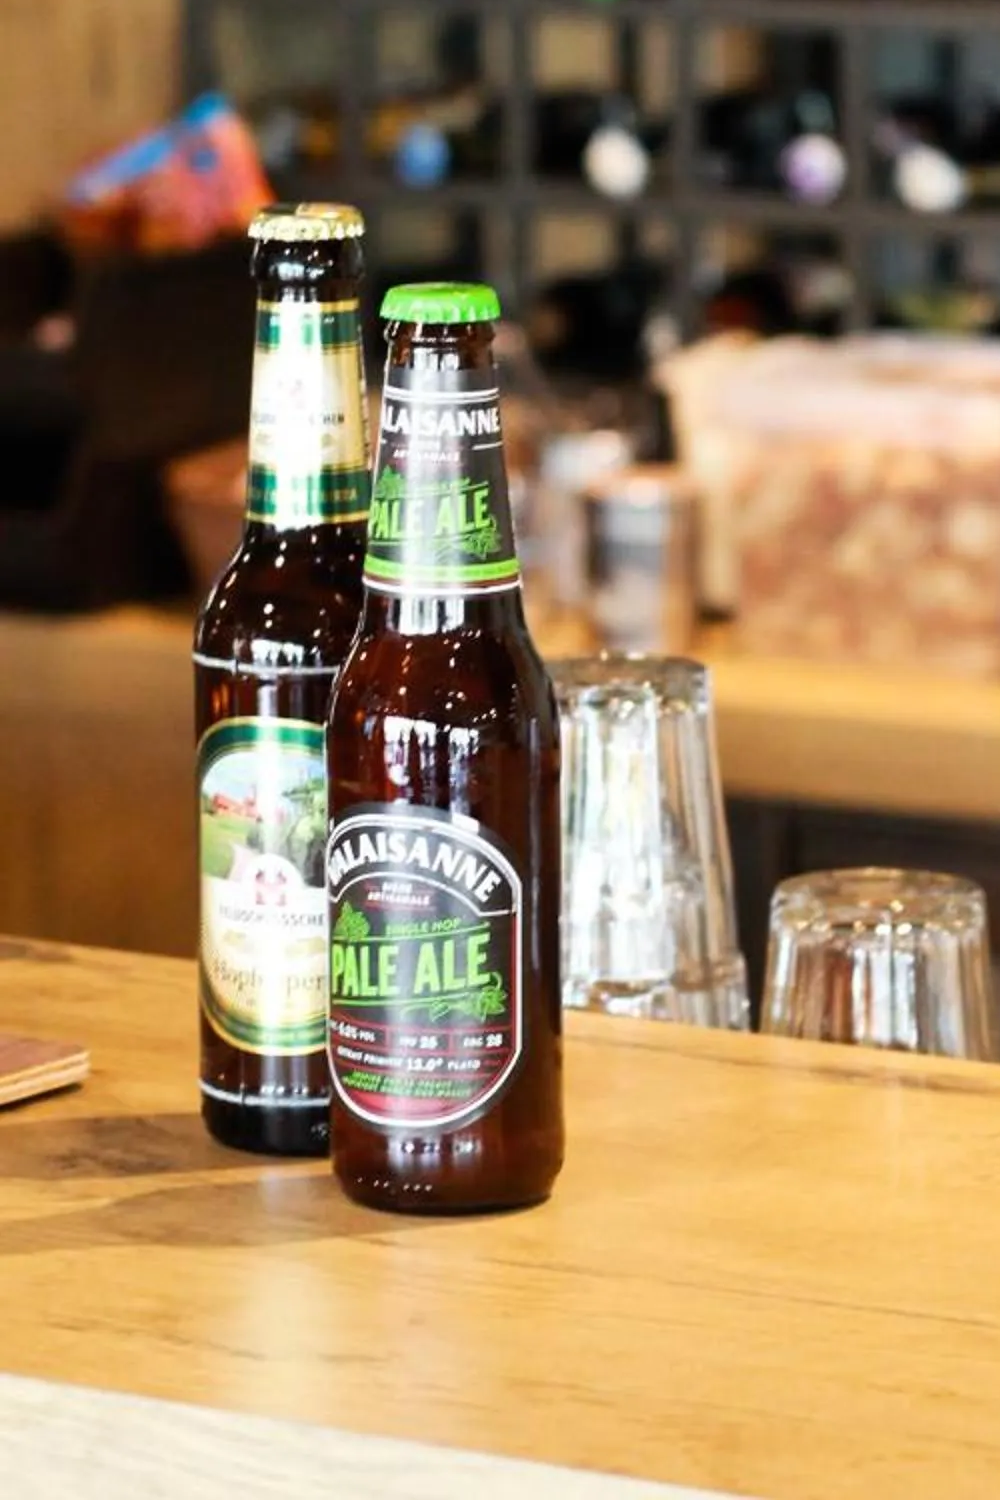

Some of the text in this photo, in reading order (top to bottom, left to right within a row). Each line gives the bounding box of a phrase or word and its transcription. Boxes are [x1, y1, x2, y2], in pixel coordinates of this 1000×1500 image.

[434, 487, 491, 537] ALE
[331, 933, 491, 997] PALE ALE
